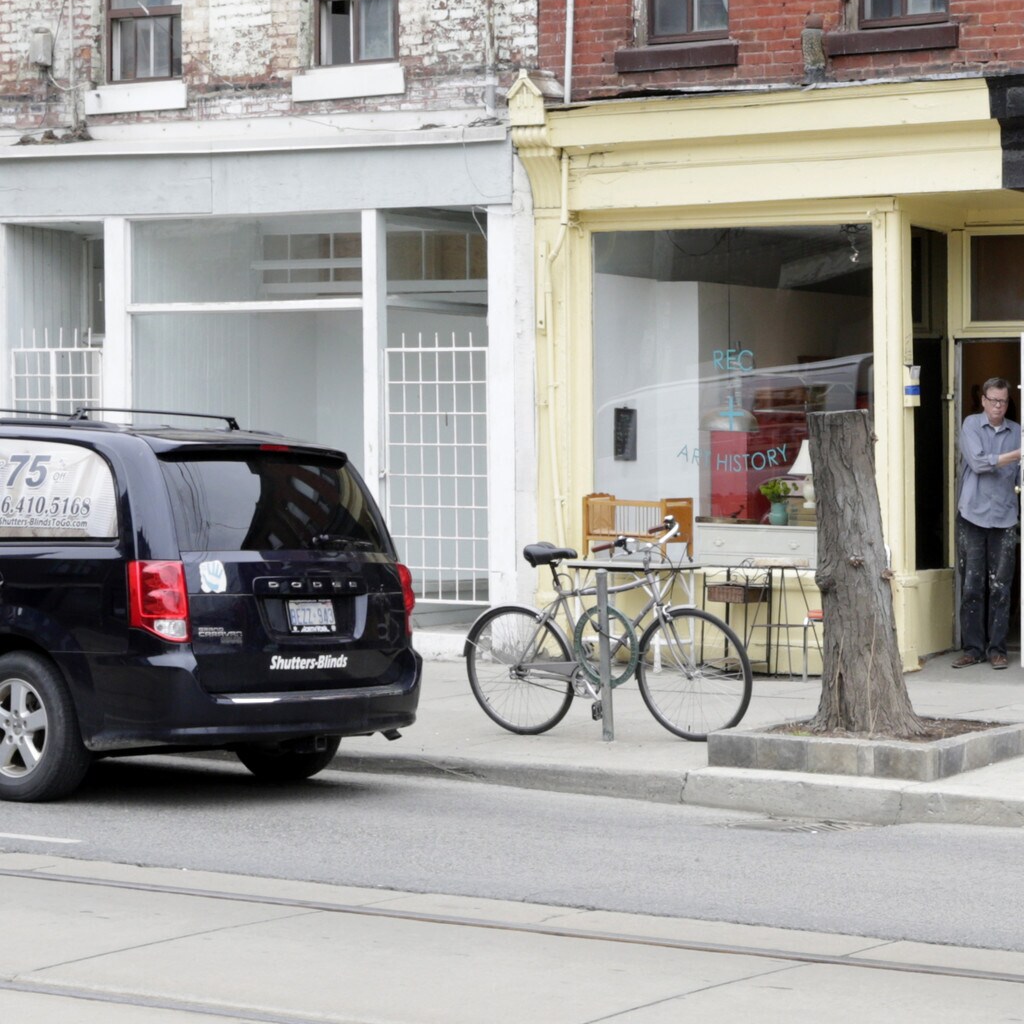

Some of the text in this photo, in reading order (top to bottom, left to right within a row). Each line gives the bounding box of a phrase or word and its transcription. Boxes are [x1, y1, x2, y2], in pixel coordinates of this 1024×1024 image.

[713, 349, 754, 372] REC
[677, 443, 788, 472] ART HISTORY
[7, 455, 51, 487] 75
[270, 654, 348, 669] Shutters-Blinds
